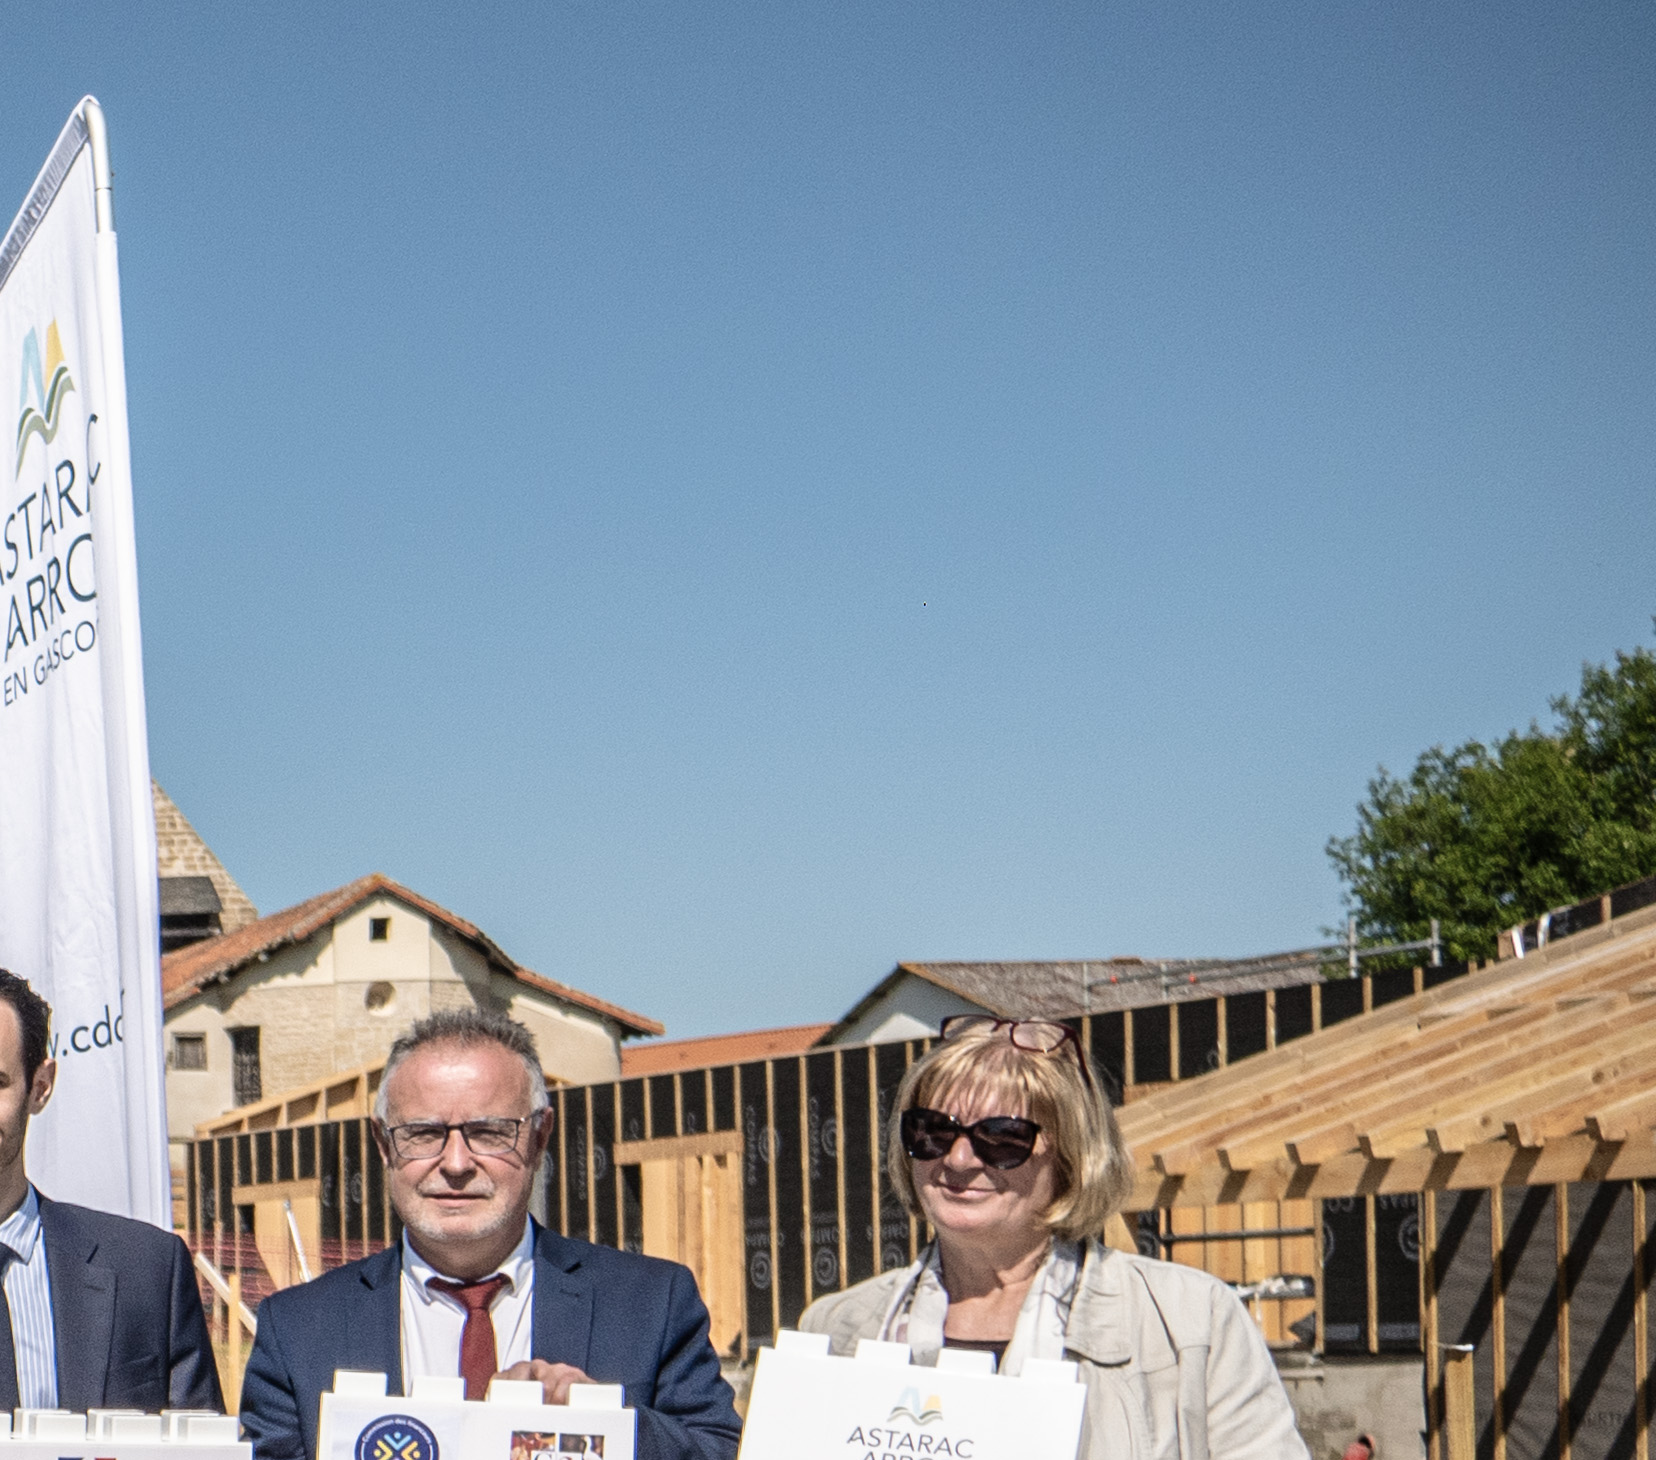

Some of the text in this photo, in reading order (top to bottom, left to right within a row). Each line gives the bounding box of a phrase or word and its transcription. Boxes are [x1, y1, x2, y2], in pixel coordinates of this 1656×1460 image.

[4, 620, 97, 707] EN GASCO
[846, 1426, 975, 1459] ASTARAC
